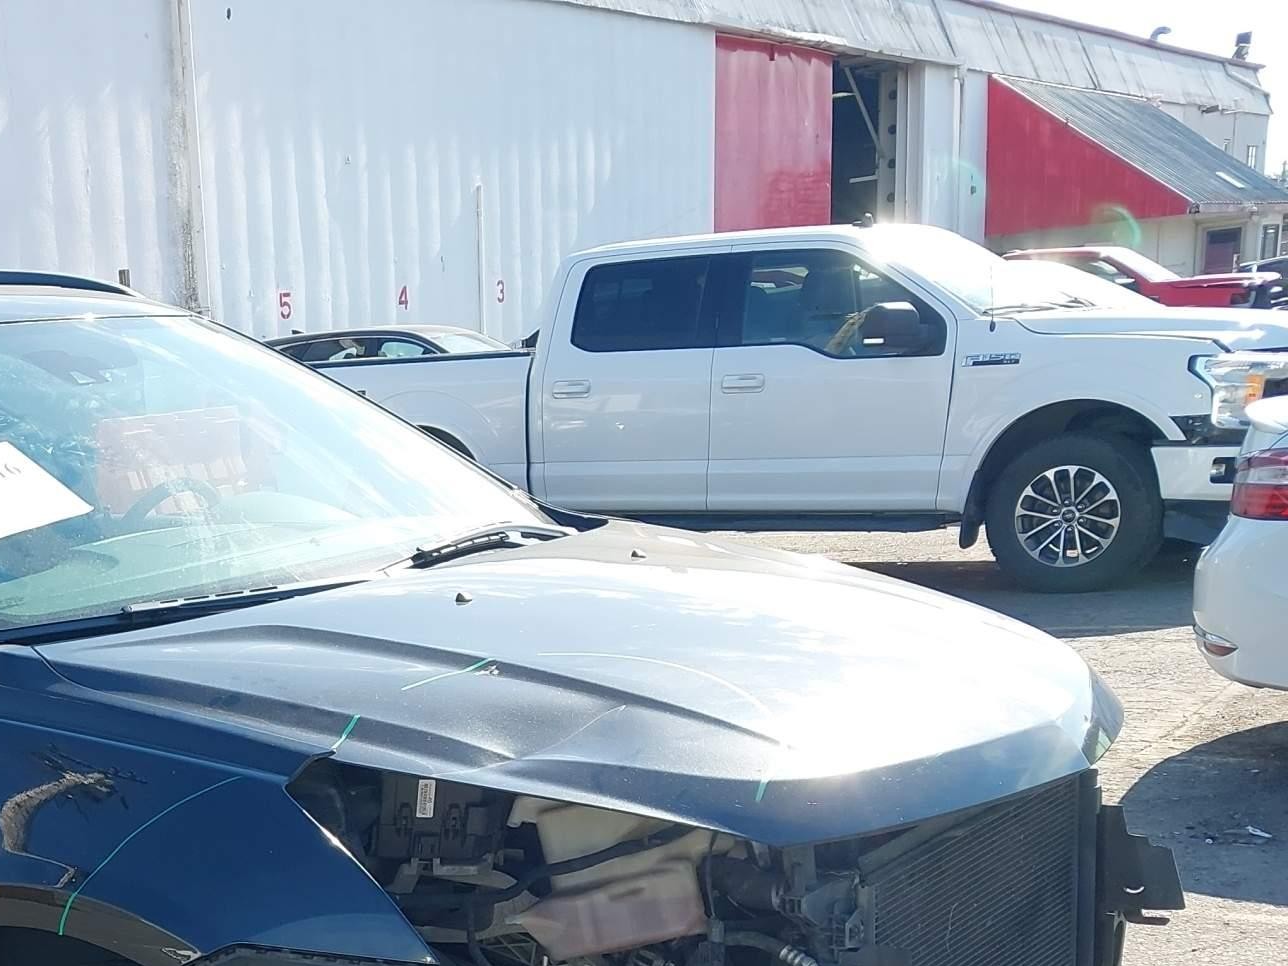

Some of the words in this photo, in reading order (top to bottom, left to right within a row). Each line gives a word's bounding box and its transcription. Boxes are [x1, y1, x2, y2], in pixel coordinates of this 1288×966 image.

[398, 285, 409, 310] 4
[496, 280, 505, 303] 3
[279, 292, 292, 319] 5
